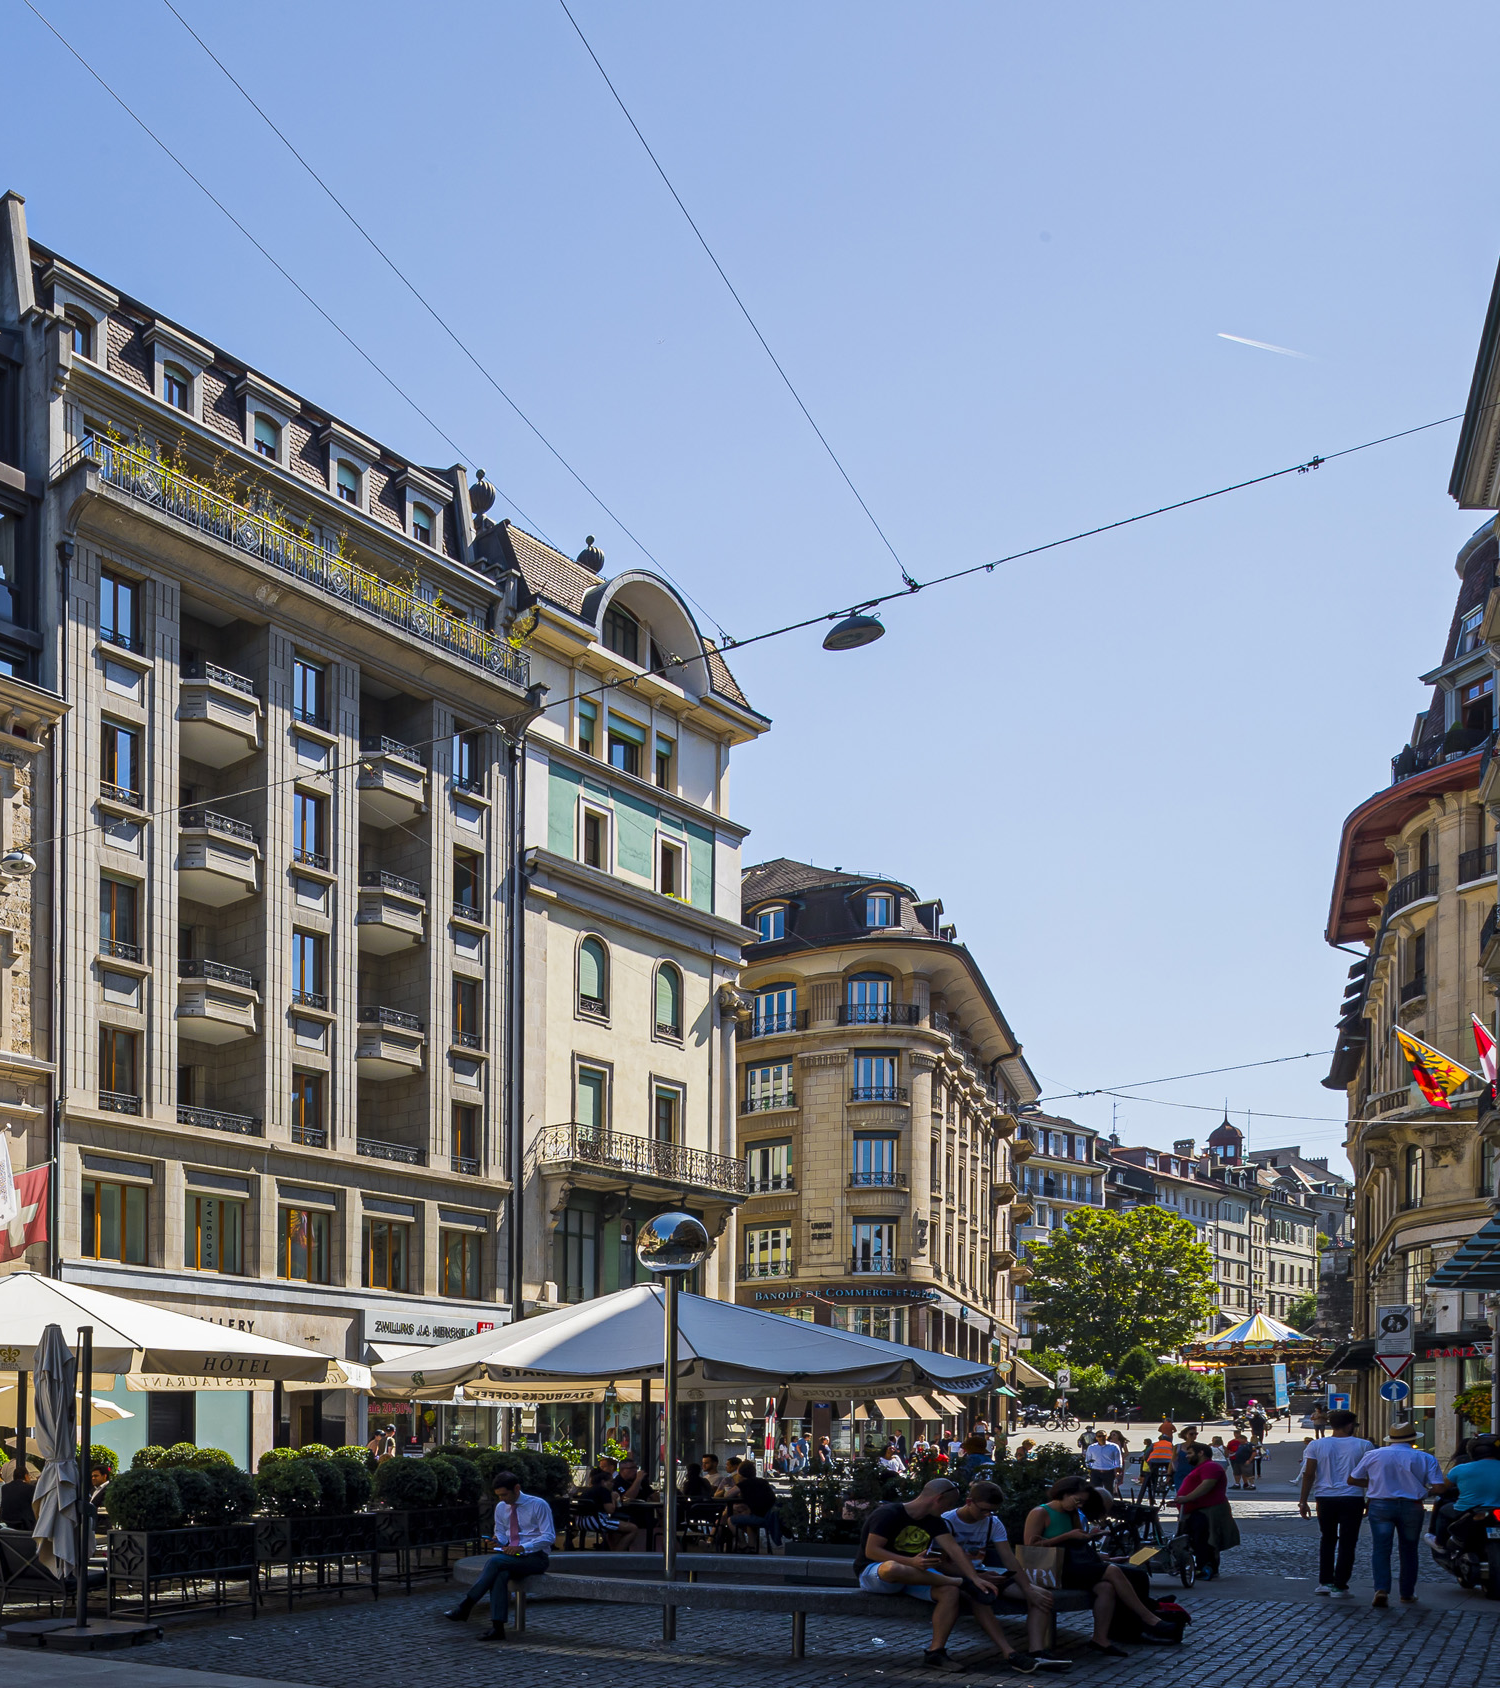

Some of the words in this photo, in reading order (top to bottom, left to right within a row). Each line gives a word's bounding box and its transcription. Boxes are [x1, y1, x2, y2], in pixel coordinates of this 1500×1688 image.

[756, 1291, 801, 1301] BANQUE
[826, 1287, 893, 1298] COMMERCE
[375, 1321, 415, 1336] ZWILLING
[433, 1326, 476, 1339] HENCKELS
[1426, 1347, 1475, 1359] FRANZ
[202, 1355, 272, 1374] HÔTEL
[1024, 1568, 1057, 1588] ARA
